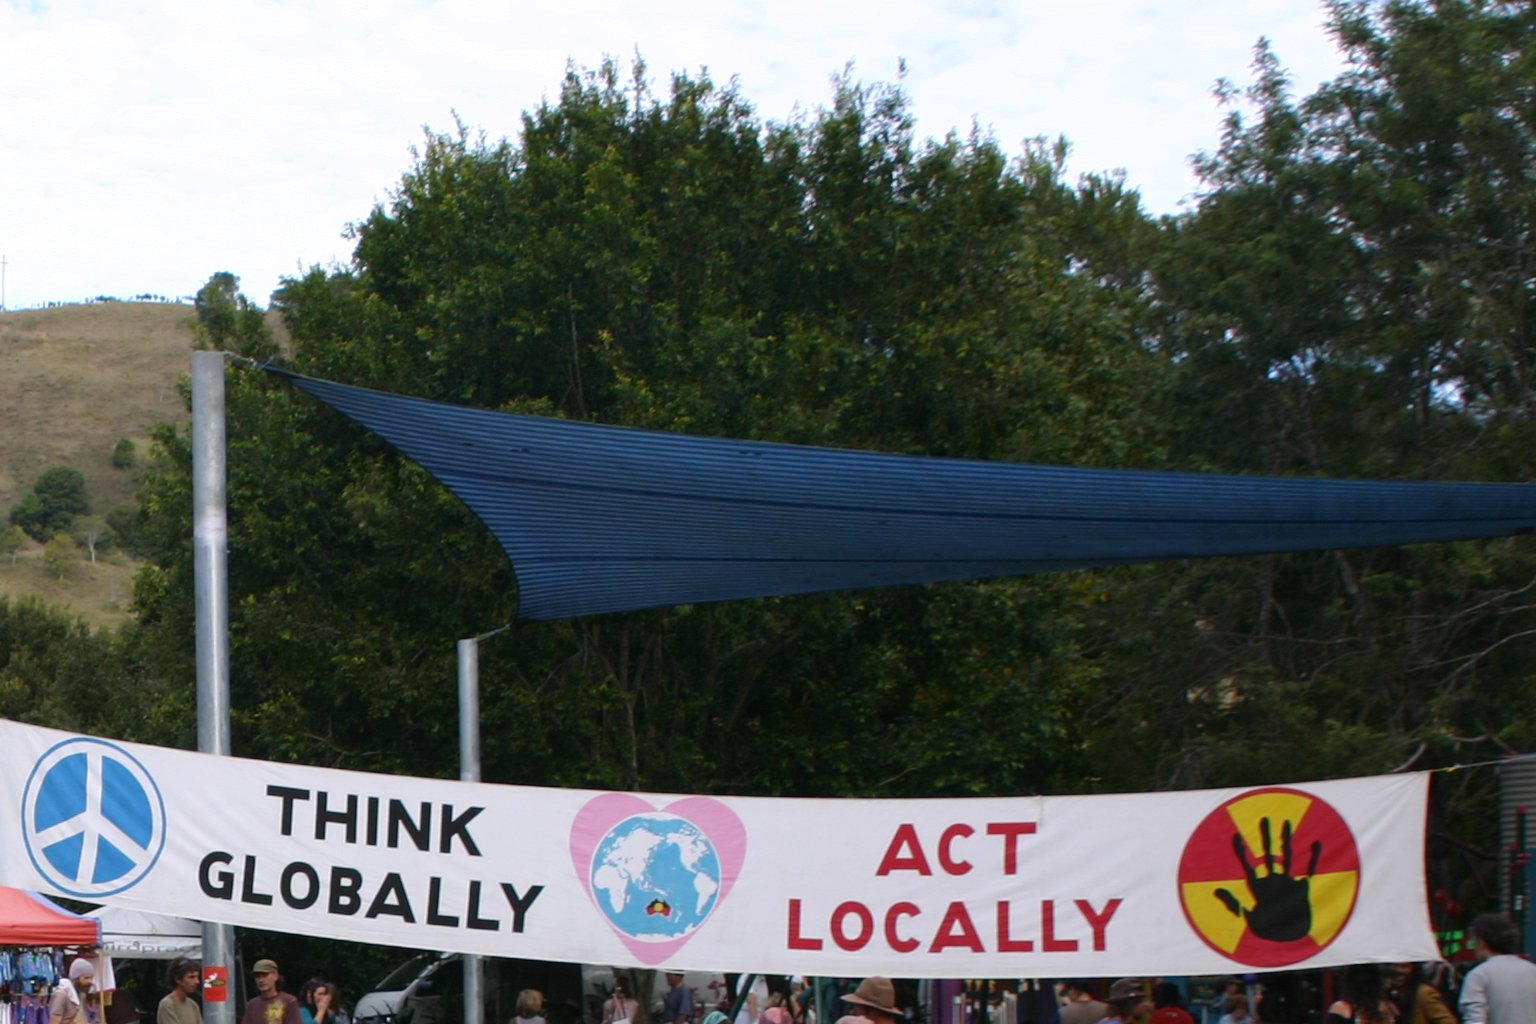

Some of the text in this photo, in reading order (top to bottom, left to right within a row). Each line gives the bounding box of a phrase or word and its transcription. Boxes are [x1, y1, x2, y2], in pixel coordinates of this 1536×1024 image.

[266, 784, 486, 857] THINK
[875, 821, 1038, 877] ACT
[197, 850, 546, 934] GLOBALLY
[786, 897, 1125, 954] LOCALLY
